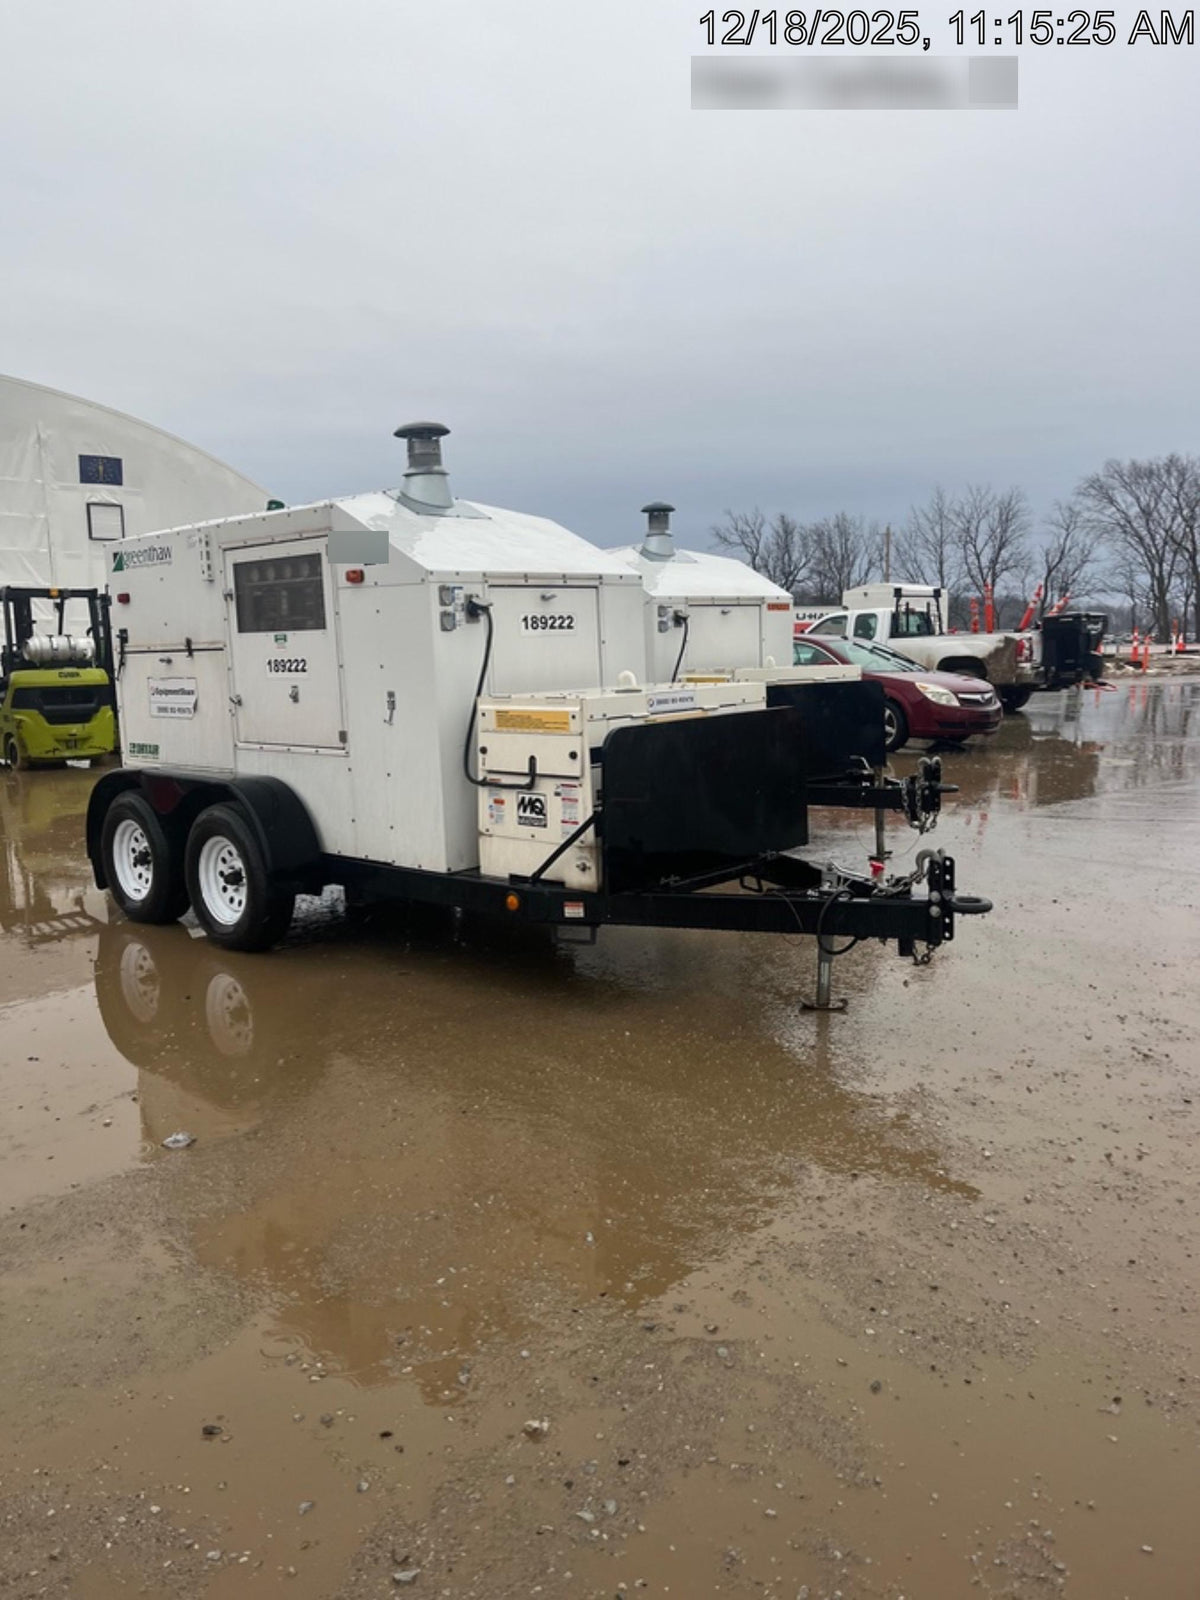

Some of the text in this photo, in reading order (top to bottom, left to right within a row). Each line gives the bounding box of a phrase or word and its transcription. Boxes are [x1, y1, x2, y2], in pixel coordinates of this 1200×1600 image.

[521, 614, 574, 630] 189222
[266, 658, 308, 673] 189222
[518, 795, 546, 816] MQ
